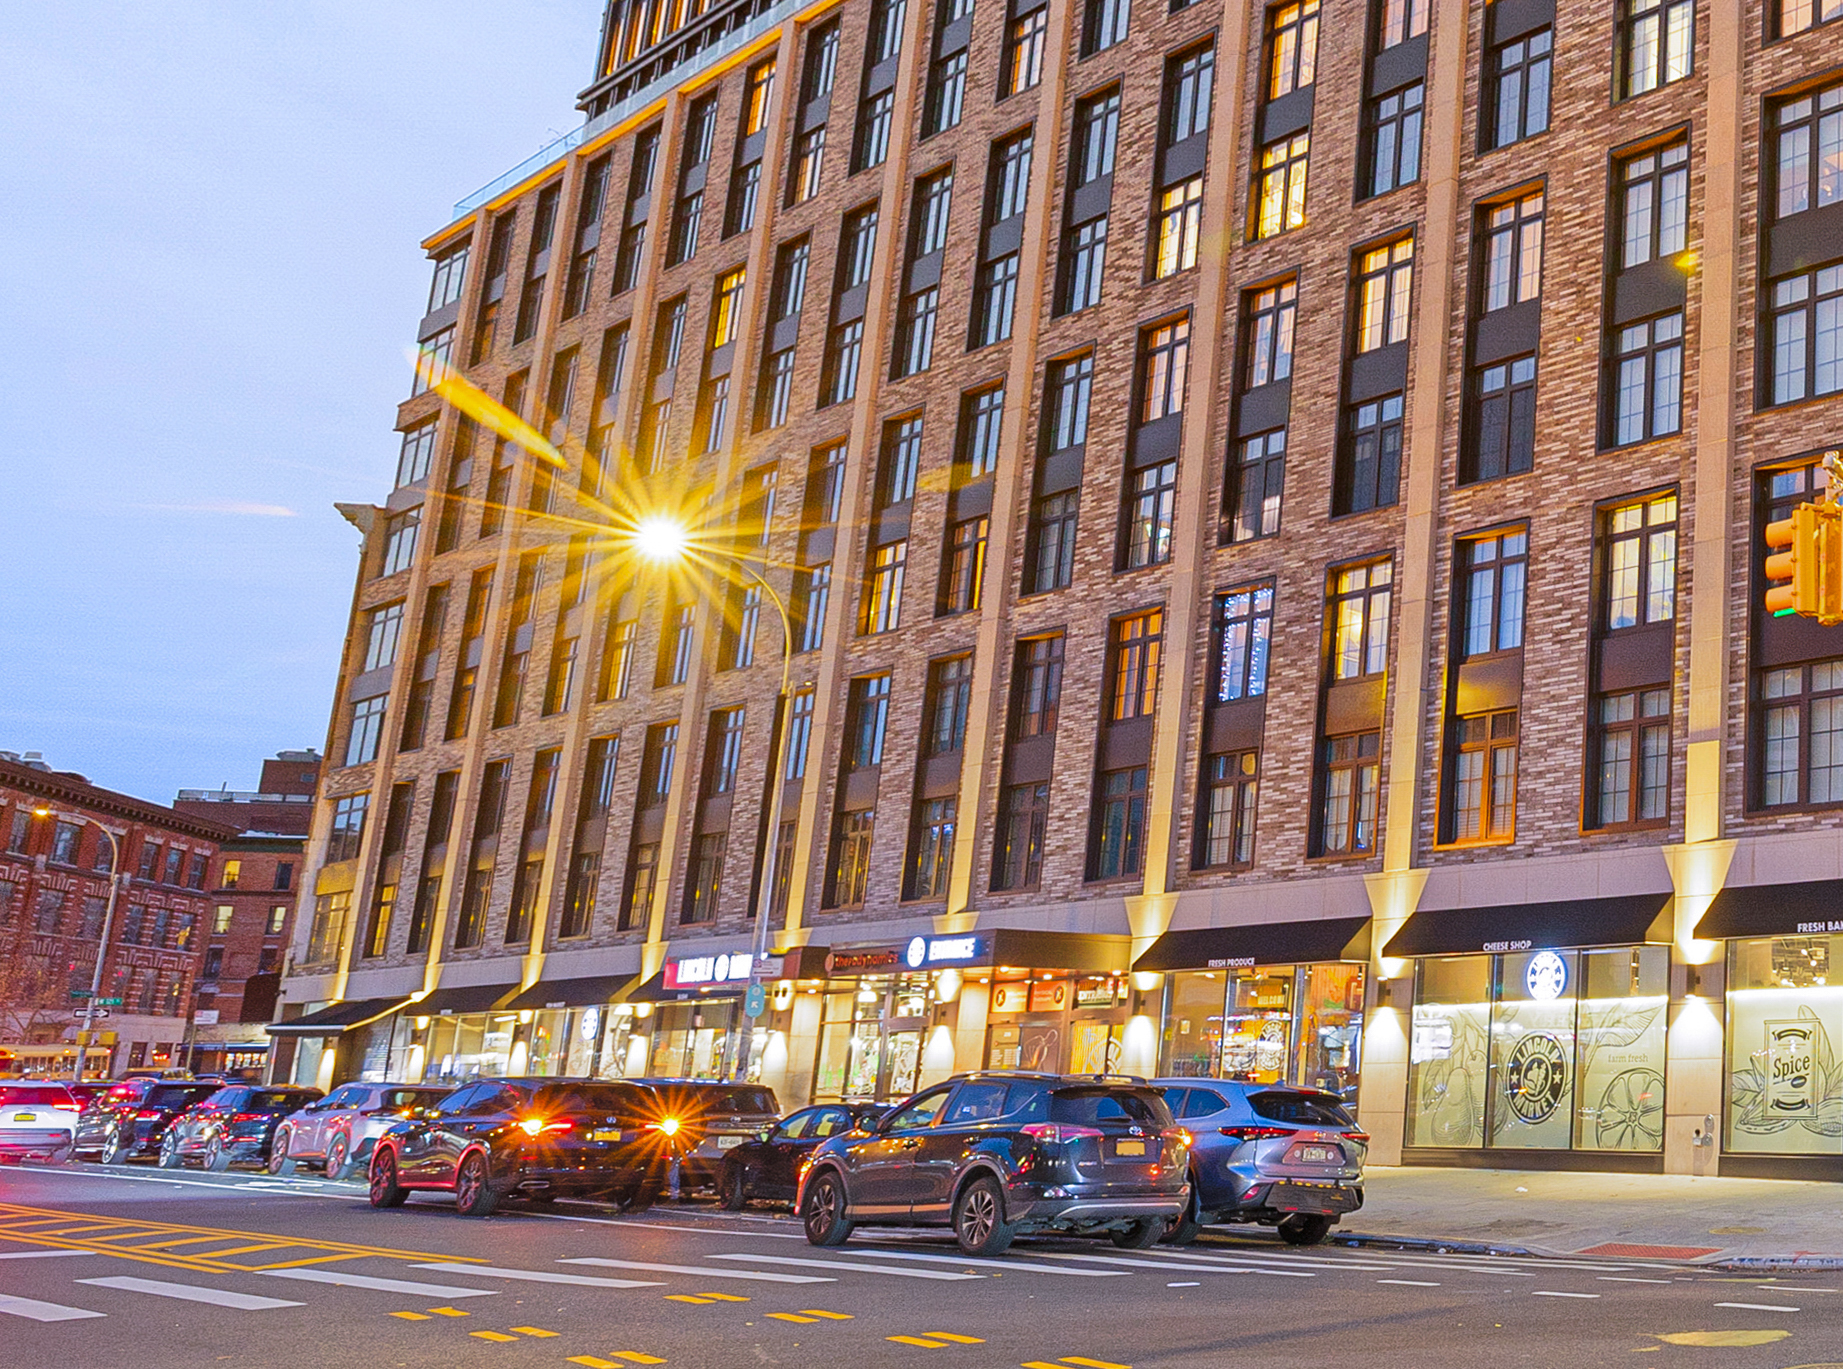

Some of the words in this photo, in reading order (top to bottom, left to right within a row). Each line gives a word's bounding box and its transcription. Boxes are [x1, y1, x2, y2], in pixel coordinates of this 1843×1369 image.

[1797, 922, 1825, 933] FRESH
[1483, 941, 1509, 951] CHEESE
[1510, 940, 1532, 949] SHOP
[1208, 959, 1226, 967] FRESH
[1227, 957, 1255, 967] PRODUCE
[1516, 1036, 1561, 1065] LINCOLN
[1628, 1053, 1648, 1062] fresh
[1773, 1055, 1810, 1080] Spice
[1513, 1090, 1555, 1118] MARKET
